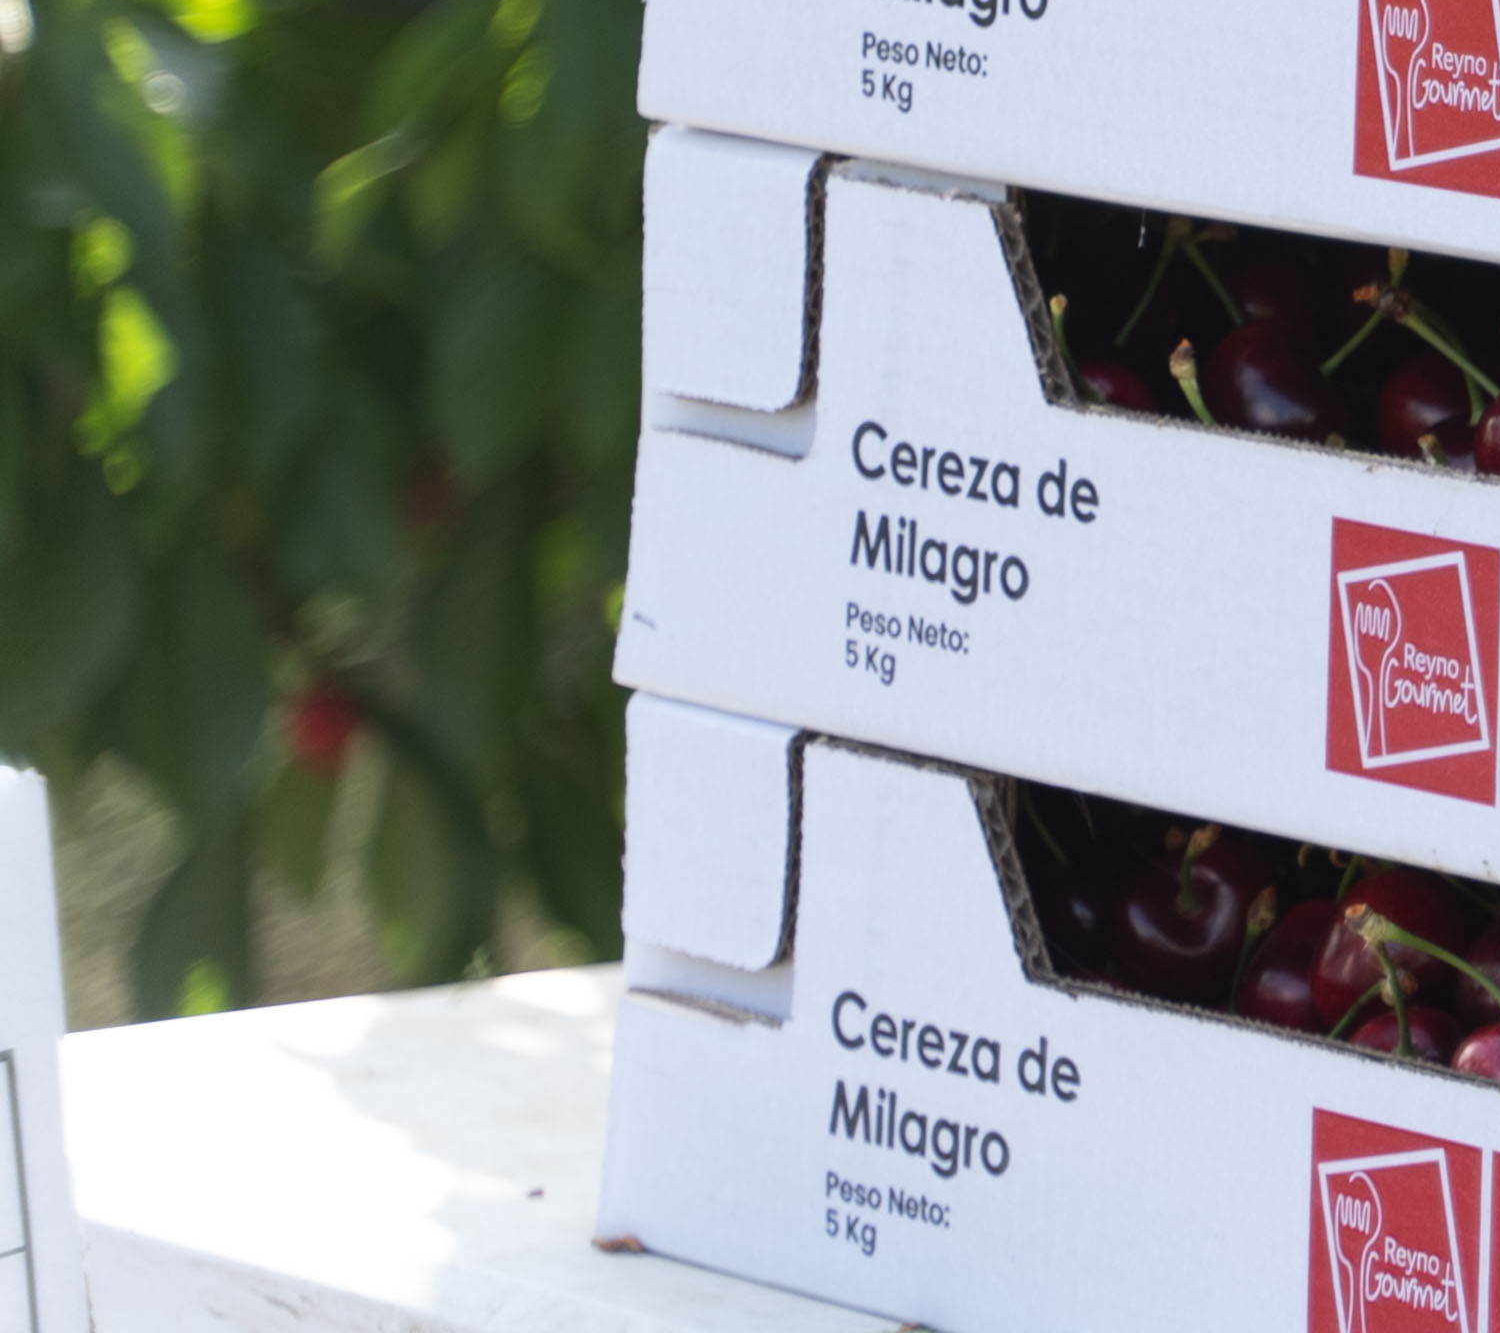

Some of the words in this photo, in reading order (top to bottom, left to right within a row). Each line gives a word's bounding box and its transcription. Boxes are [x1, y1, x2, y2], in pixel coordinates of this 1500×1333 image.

[862, 31, 918, 65] Peso
[926, 40, 988, 77] Neto:
[1432, 43, 1487, 78] Reyno
[862, 69, 874, 97] 5
[882, 73, 912, 113] Kg
[852, 420, 1020, 508] Cereza
[1037, 458, 1099, 523] de
[850, 509, 1029, 605] Milagro
[846, 602, 902, 639] Peso
[908, 615, 970, 654] Neto:
[846, 640, 858, 667] 5
[866, 645, 896, 685] Kg
[1404, 643, 1459, 678] Reyno
[1384, 658, 1478, 724] Gourmet
[832, 989, 1000, 1085] Cereza
[1017, 1035, 1080, 1102] de
[829, 1079, 1010, 1179] Milagro
[826, 1171, 882, 1211] Peso
[888, 1187, 950, 1228] Neto:
[826, 1209, 838, 1237] 5
[846, 1214, 876, 1257] Kg
[1384, 1237, 1439, 1275] Reyno
[1365, 1251, 1458, 1322] Gourmet
